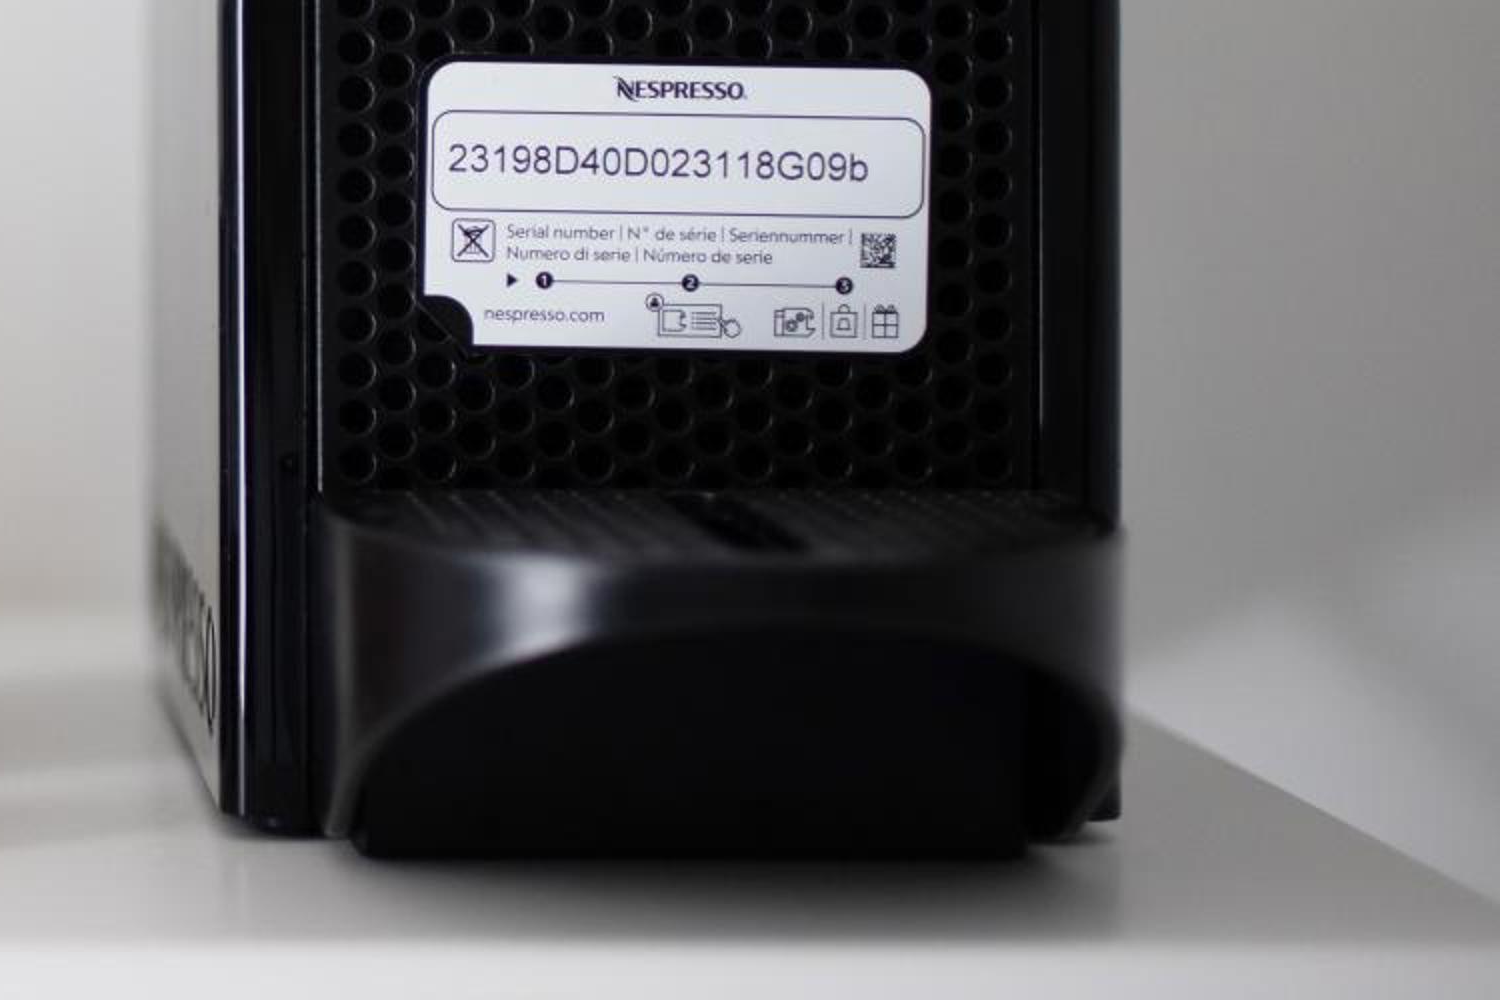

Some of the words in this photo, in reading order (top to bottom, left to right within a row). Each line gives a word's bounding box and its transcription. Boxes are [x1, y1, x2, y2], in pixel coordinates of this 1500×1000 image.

[614, 76, 744, 102] NESPRESSO
[448, 143, 869, 182] 23198D40D023118G09b
[507, 225, 549, 239] Serial
[553, 226, 614, 241] number
[655, 228, 675, 241] de
[680, 227, 717, 242] série
[729, 228, 845, 244] Seriennummer
[507, 247, 569, 261] Numero
[573, 247, 590, 262] di
[593, 248, 631, 263] serie
[643, 247, 707, 263] Número
[711, 250, 731, 264] de
[736, 250, 773, 265] serie
[484, 306, 605, 324] nespresso.com
